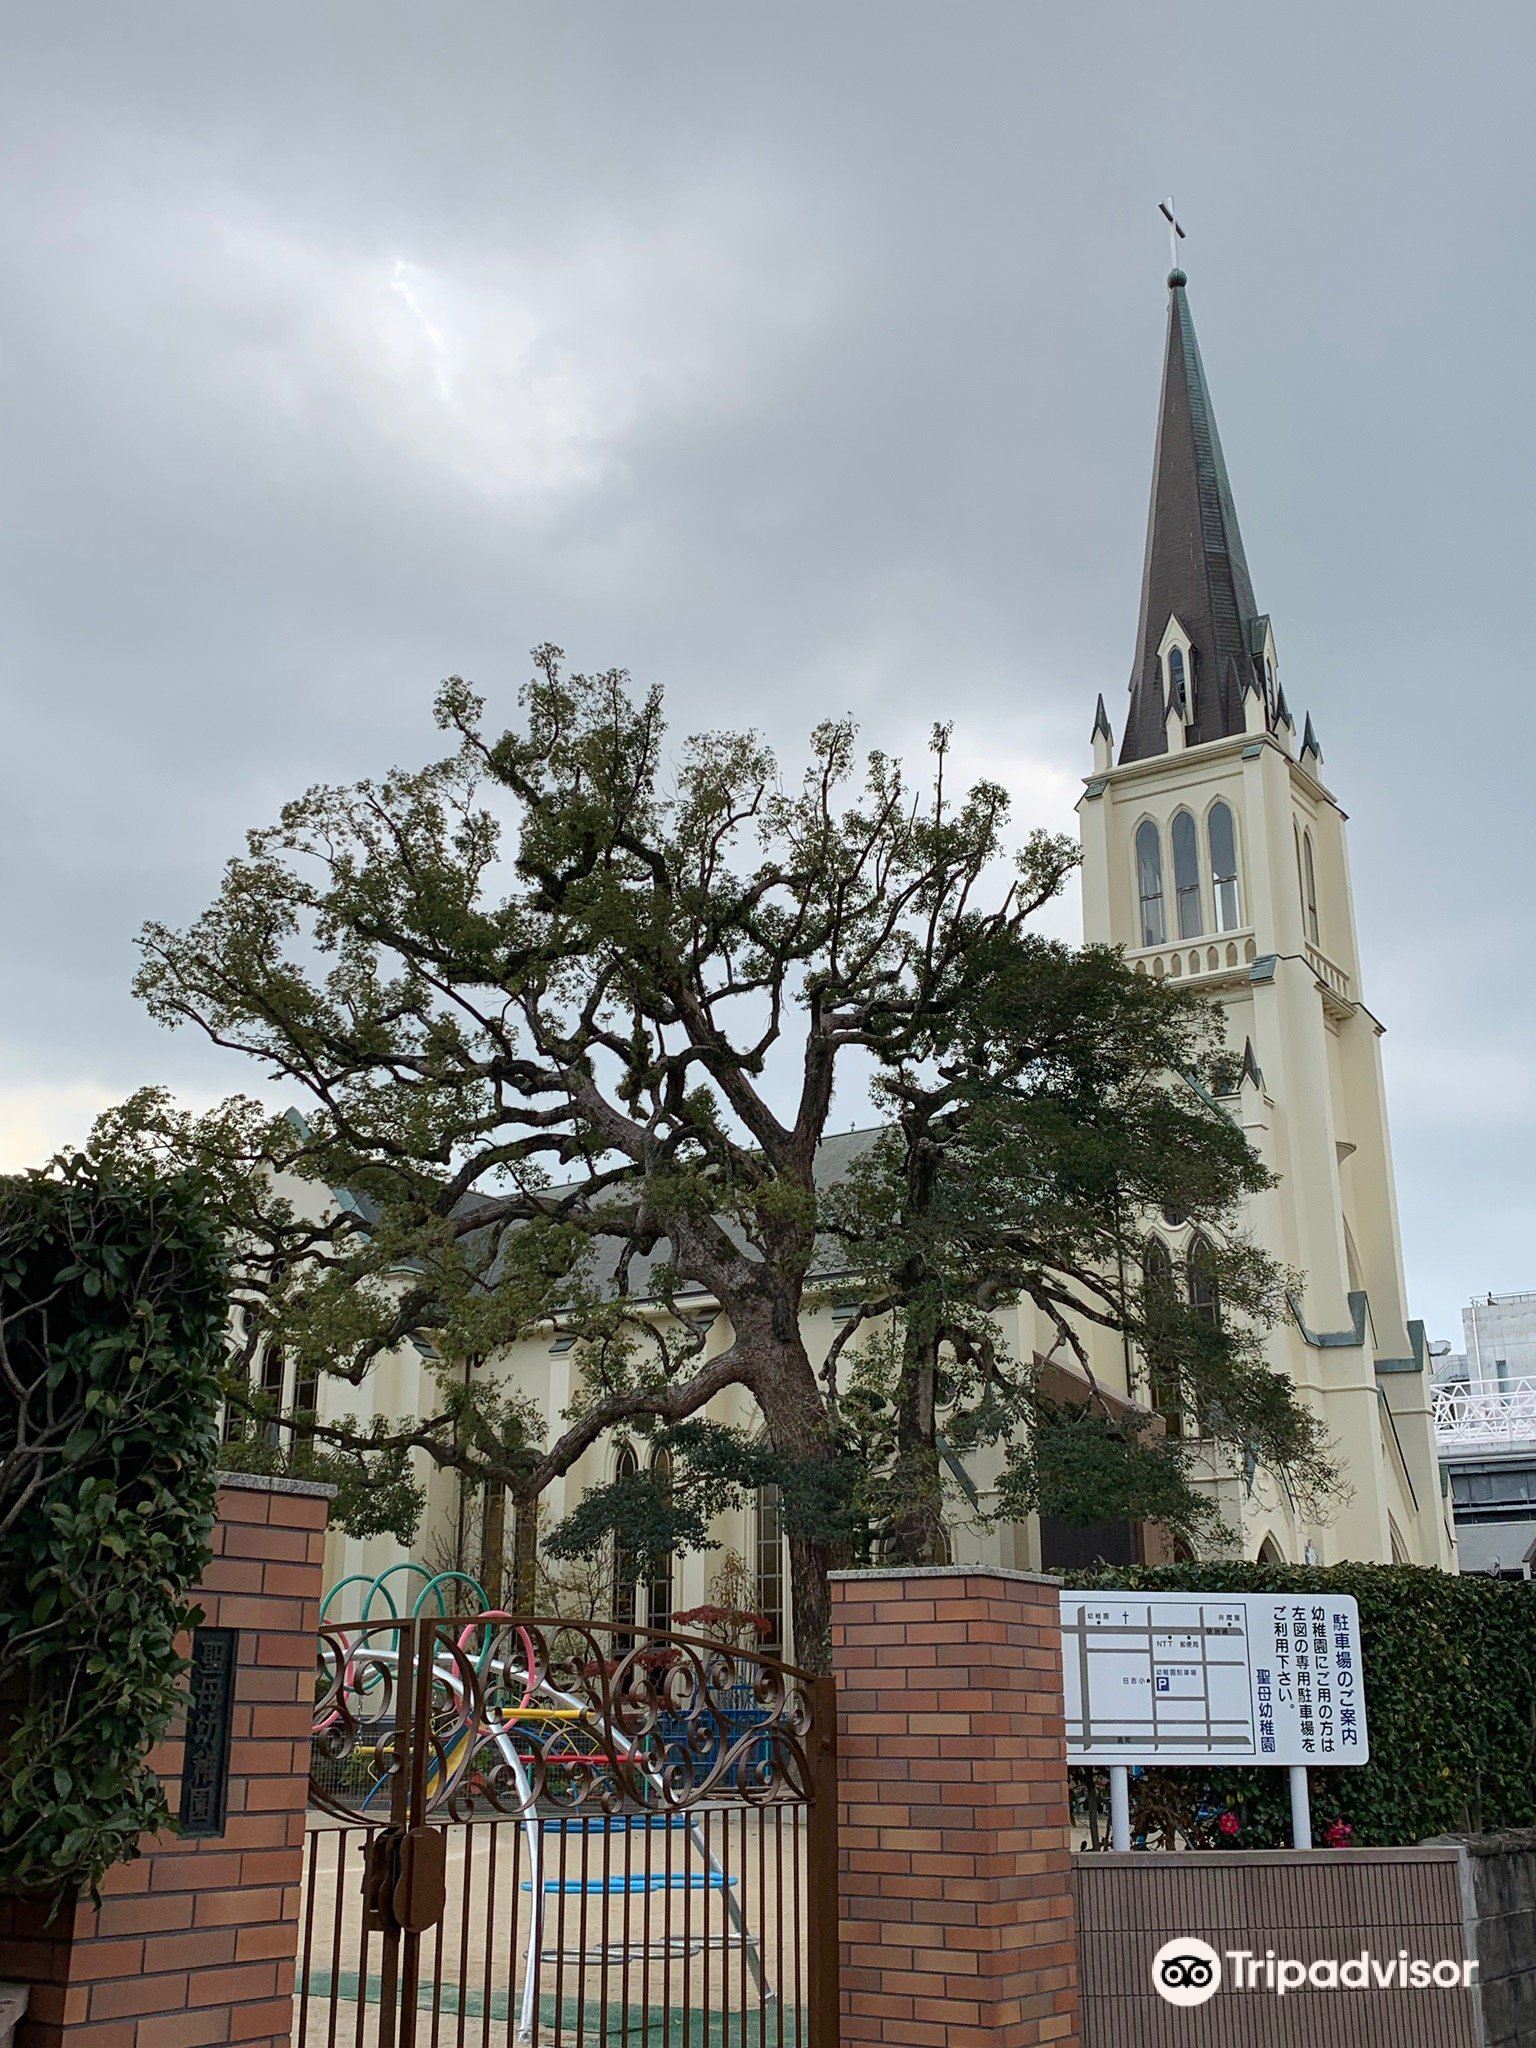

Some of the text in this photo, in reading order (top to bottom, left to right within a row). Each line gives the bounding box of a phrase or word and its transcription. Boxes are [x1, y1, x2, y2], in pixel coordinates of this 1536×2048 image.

[1156, 1640, 1173, 1648] NTT
[1273, 1605, 1295, 1709] ご利用下さい。
[1291, 1606, 1316, 1753] 左図の専用駐車場を
[1311, 1606, 1335, 1753] 幼稚園にご用の方は
[1333, 1613, 1358, 1746] 駐車場のご案内
[1256, 1669, 1276, 1753] 聖母幼稚園
